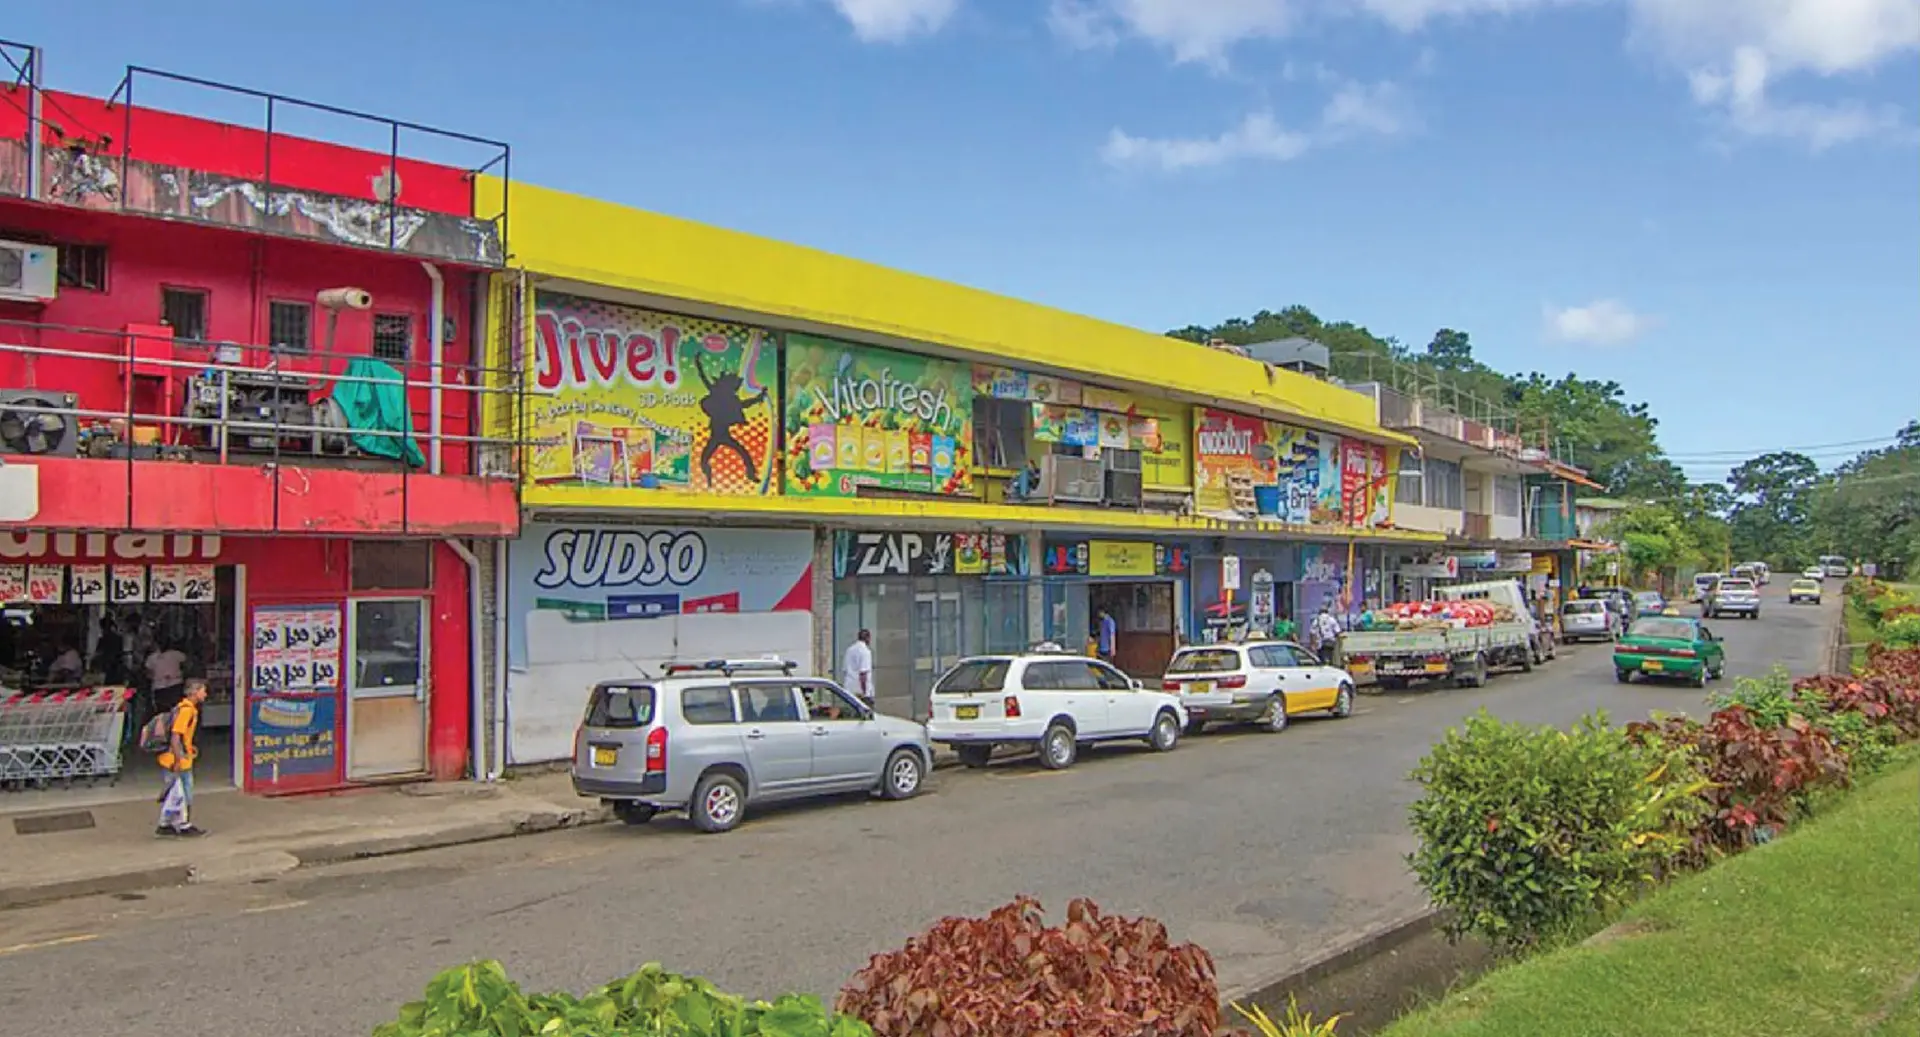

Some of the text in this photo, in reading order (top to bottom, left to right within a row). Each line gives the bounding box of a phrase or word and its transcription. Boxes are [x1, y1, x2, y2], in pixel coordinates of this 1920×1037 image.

[535, 310, 681, 391] Jive!
[814, 367, 951, 431] Vitafresh
[535, 529, 707, 588] SUDSO
[857, 533, 924, 574] ZAP
[253, 743, 334, 765] good taste!
[254, 735, 282, 748] The
